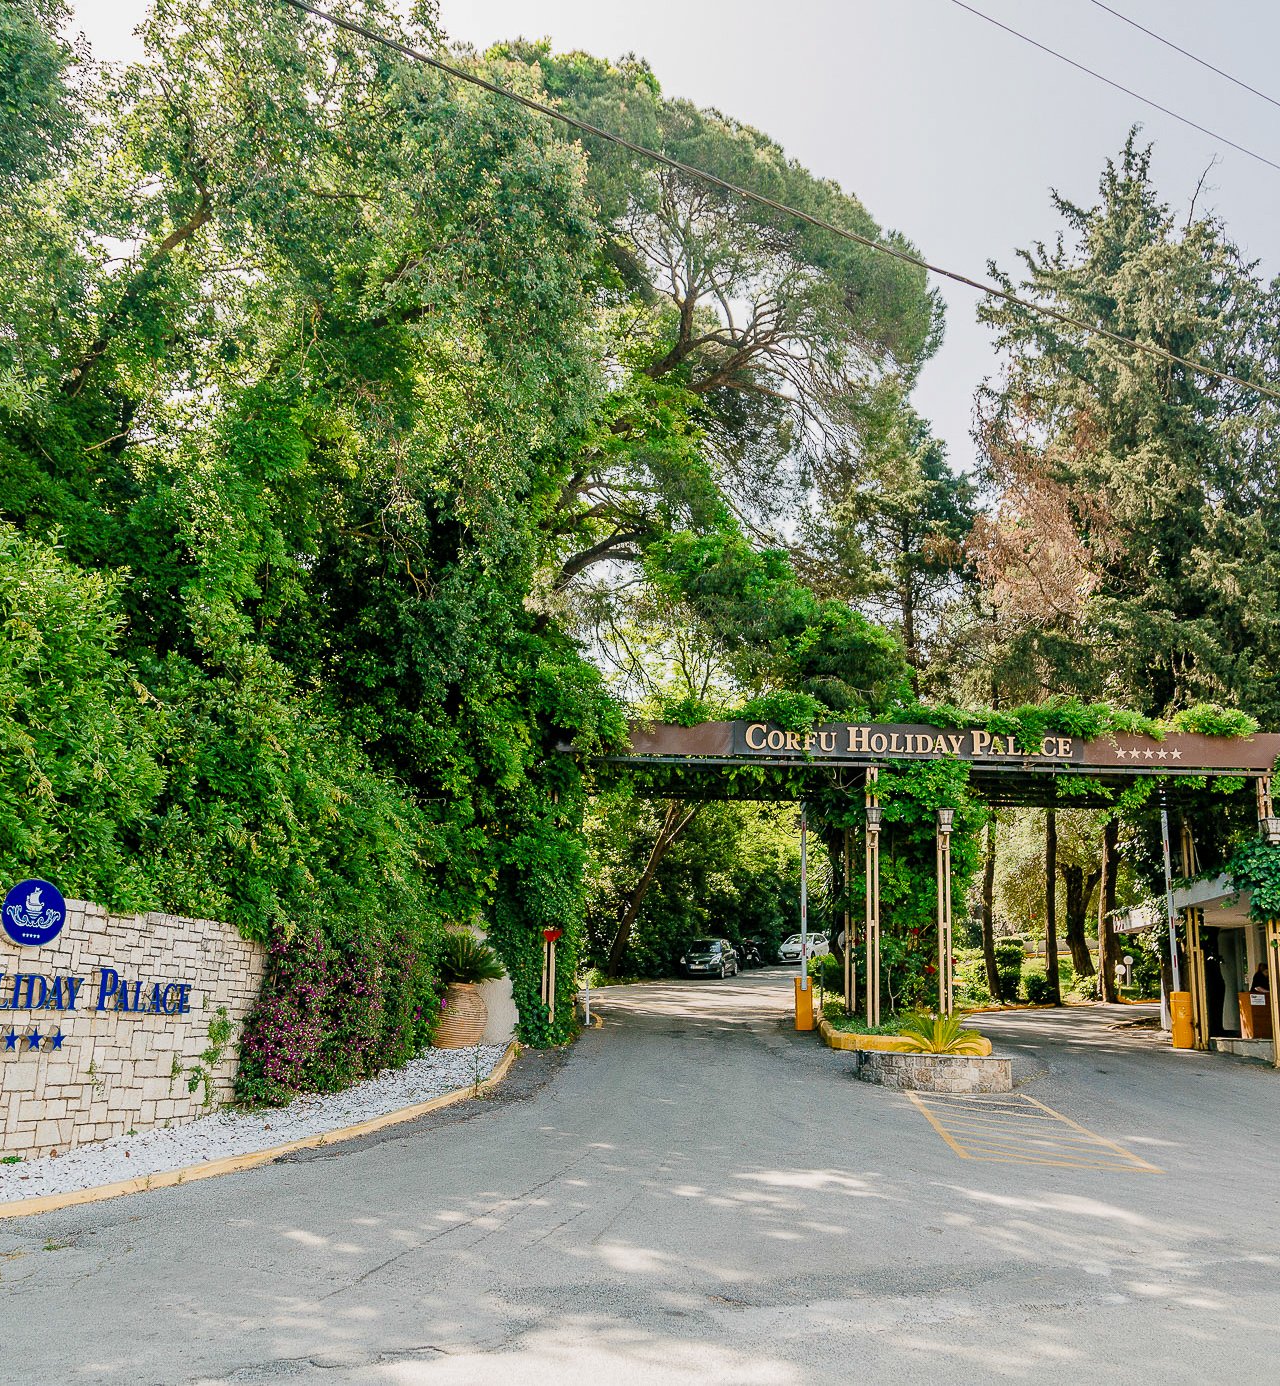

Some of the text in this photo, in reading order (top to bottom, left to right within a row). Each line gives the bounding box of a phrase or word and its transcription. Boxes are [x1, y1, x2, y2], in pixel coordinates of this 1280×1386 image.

[745, 723, 1073, 758] CORFU HOLIDAY PALCE
[95, 968, 192, 1014] PALACE
